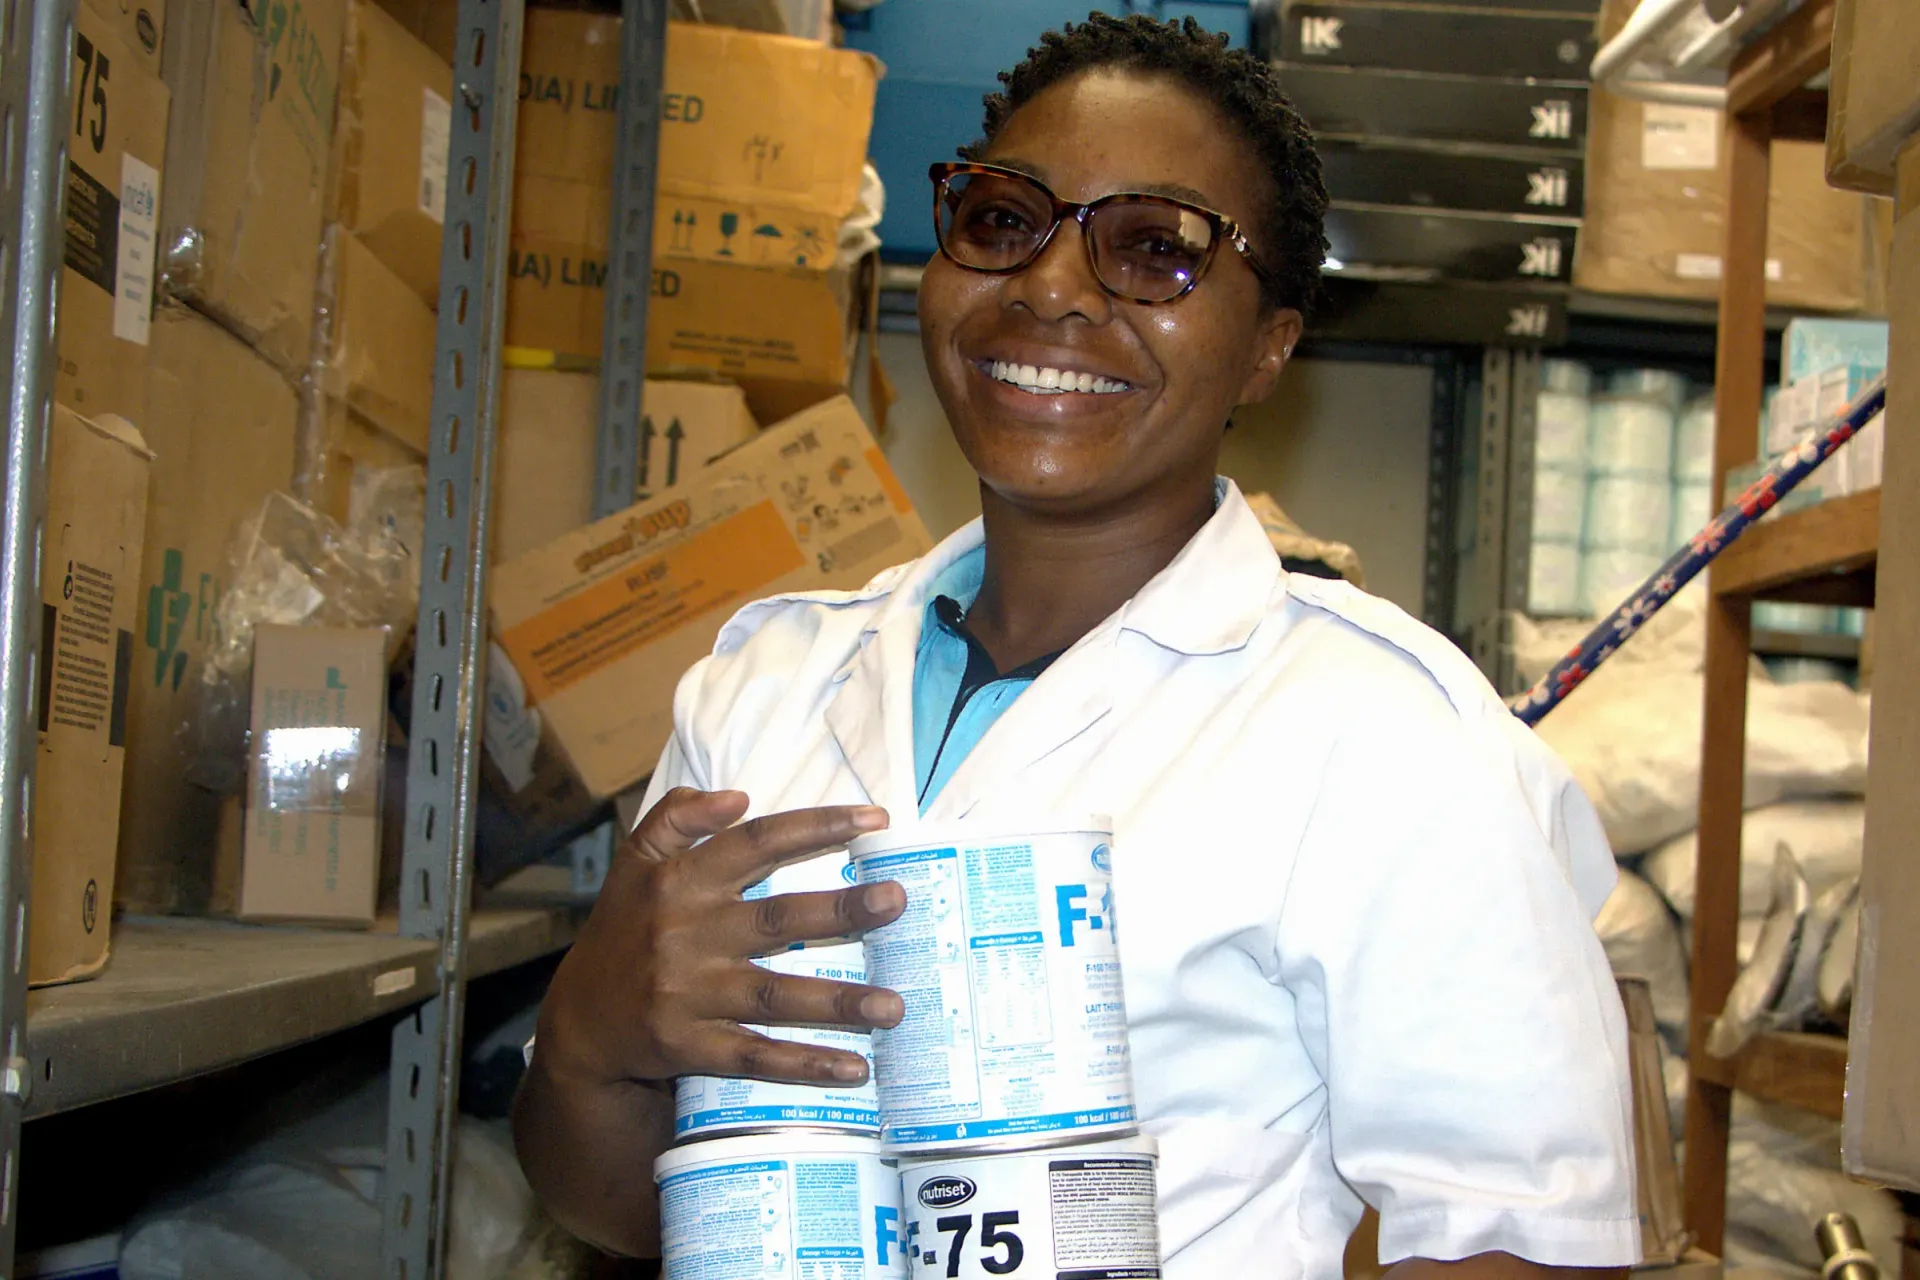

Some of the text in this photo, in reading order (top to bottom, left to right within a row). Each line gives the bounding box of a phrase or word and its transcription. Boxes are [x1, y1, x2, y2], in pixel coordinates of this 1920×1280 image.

[76, 31, 110, 154] 75
[816, 968, 842, 978] F-100
[781, 1109, 797, 1118] 100
[798, 1110, 818, 1119] kcal
[819, 1109, 824, 1119] /
[827, 1110, 842, 1119] 100
[844, 1111, 855, 1121] ml
[856, 1113, 866, 1122] of
[922, 1182, 967, 1201] nutriset
